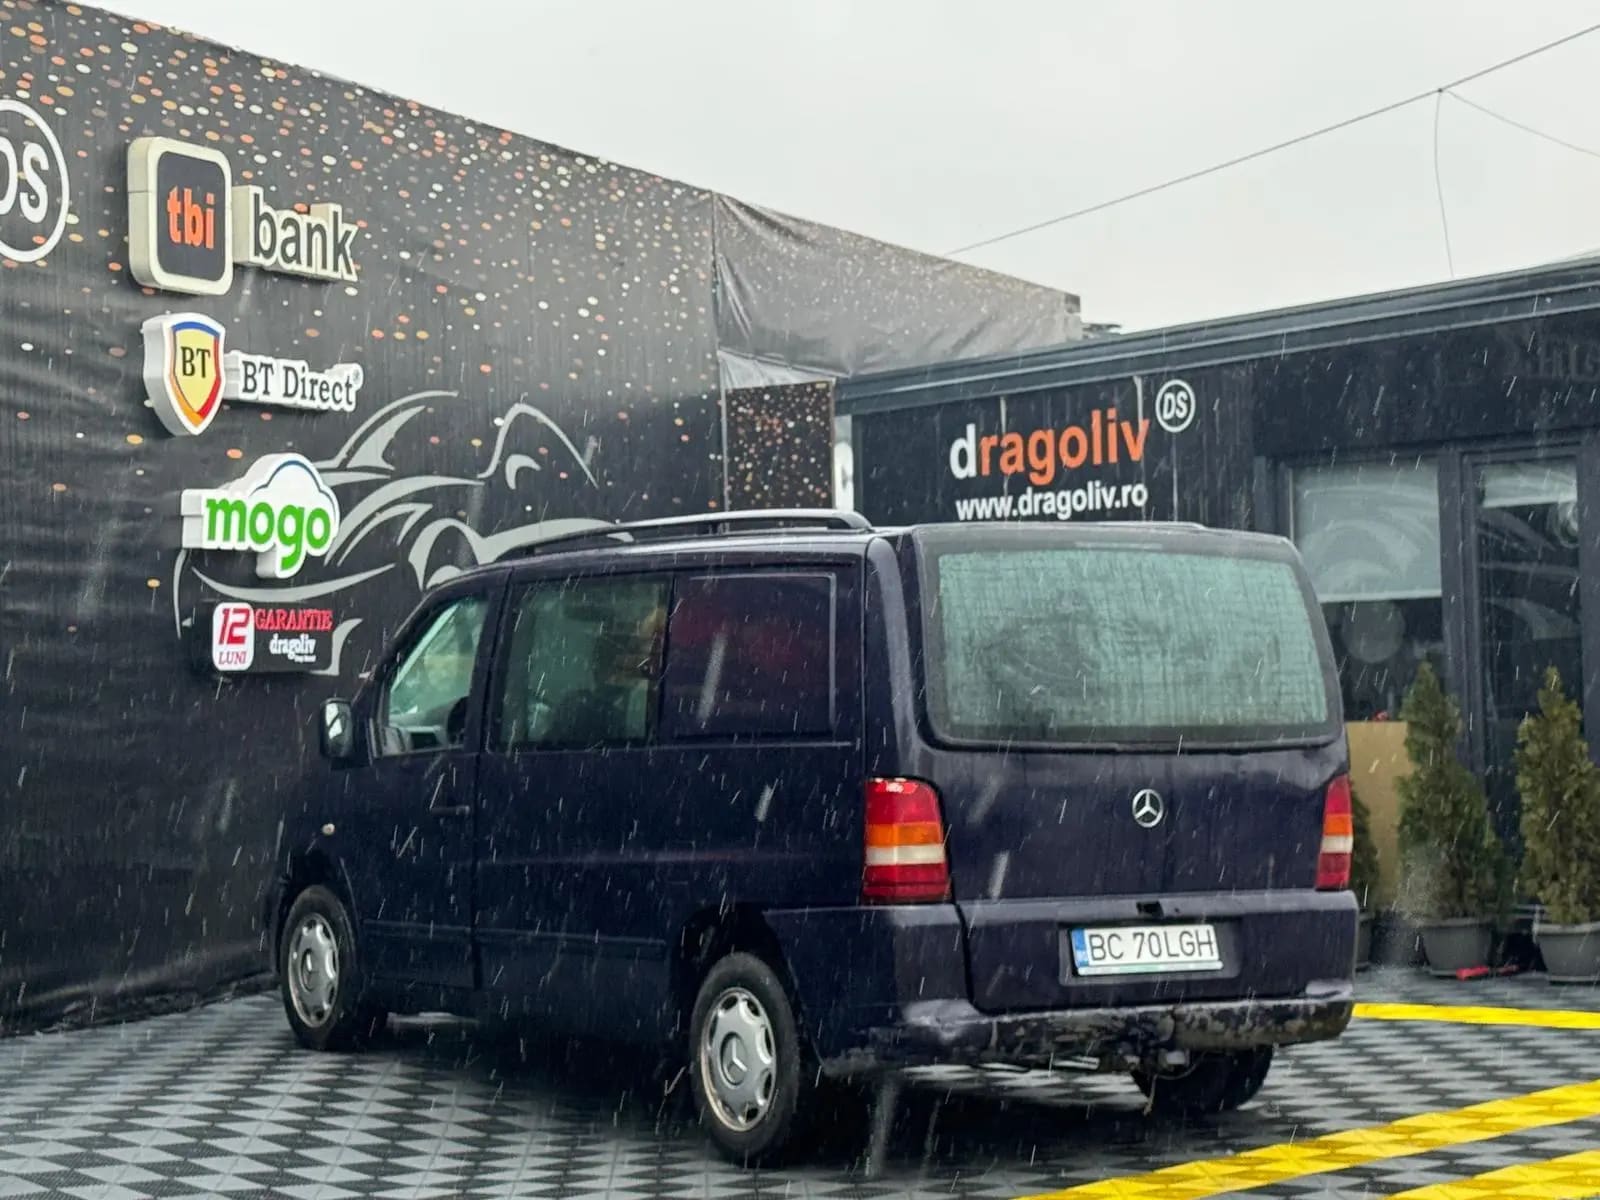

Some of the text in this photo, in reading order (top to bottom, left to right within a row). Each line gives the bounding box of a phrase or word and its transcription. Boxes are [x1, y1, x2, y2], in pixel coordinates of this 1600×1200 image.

[166, 185, 354, 275] tbi bank
[180, 346, 211, 379] BT
[242, 361, 353, 405] BT Direct
[1162, 391, 1188, 420] DS
[949, 407, 1149, 485] dragoliv
[956, 480, 1148, 521] www.dragoliv.ro
[206, 498, 332, 571] mogo
[219, 607, 334, 645] 12 GARANTIE
[218, 651, 247, 665] LUNI
[269, 633, 316, 660] dragoliv
[1088, 933, 1124, 961] BC
[1132, 929, 1214, 960] 70LGH
